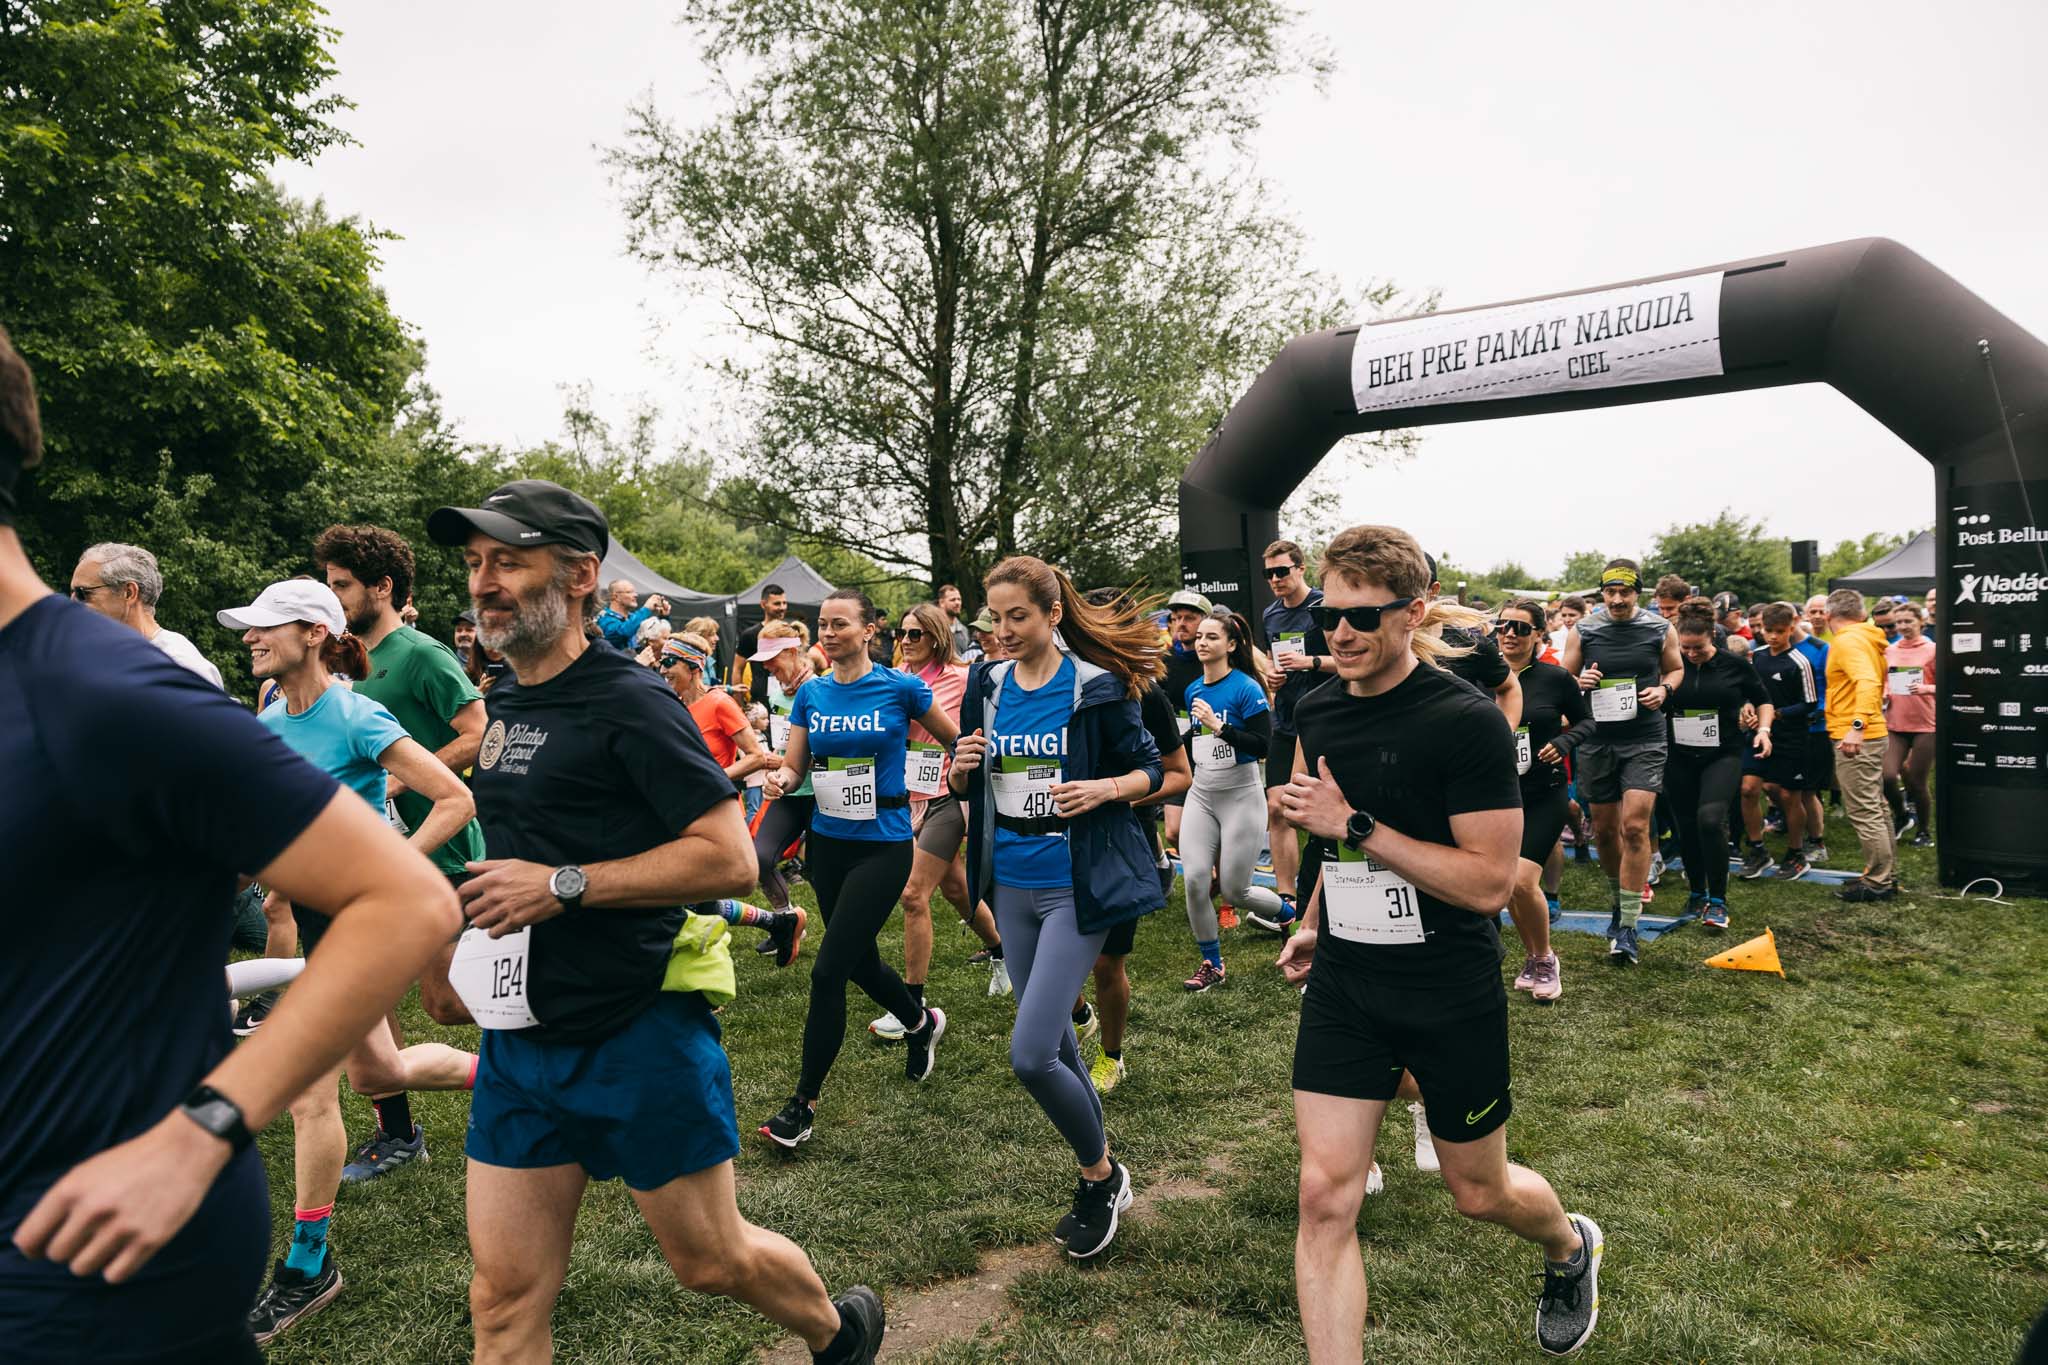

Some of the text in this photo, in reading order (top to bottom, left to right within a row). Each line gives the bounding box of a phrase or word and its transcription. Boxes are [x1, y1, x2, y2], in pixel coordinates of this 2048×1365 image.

[1368, 351, 1414, 389] BEH
[1421, 339, 1467, 378] PRE
[1567, 351, 1610, 379] CIEL
[1958, 530, 1996, 546] Post
[1201, 580, 1239, 593] Bellum
[1980, 591, 2039, 605] Tipsport
[1620, 695, 1634, 711] 37
[809, 710, 886, 734] STENGL
[1702, 724, 1717, 738] 46
[505, 723, 548, 746] Pilates
[1212, 744, 1233, 760] 488
[1517, 747, 1529, 762] 6
[918, 765, 940, 782] 158
[842, 784, 872, 806] 366
[1023, 792, 1056, 817] 487
[1385, 886, 1414, 919] 31
[492, 956, 523, 999] 124
